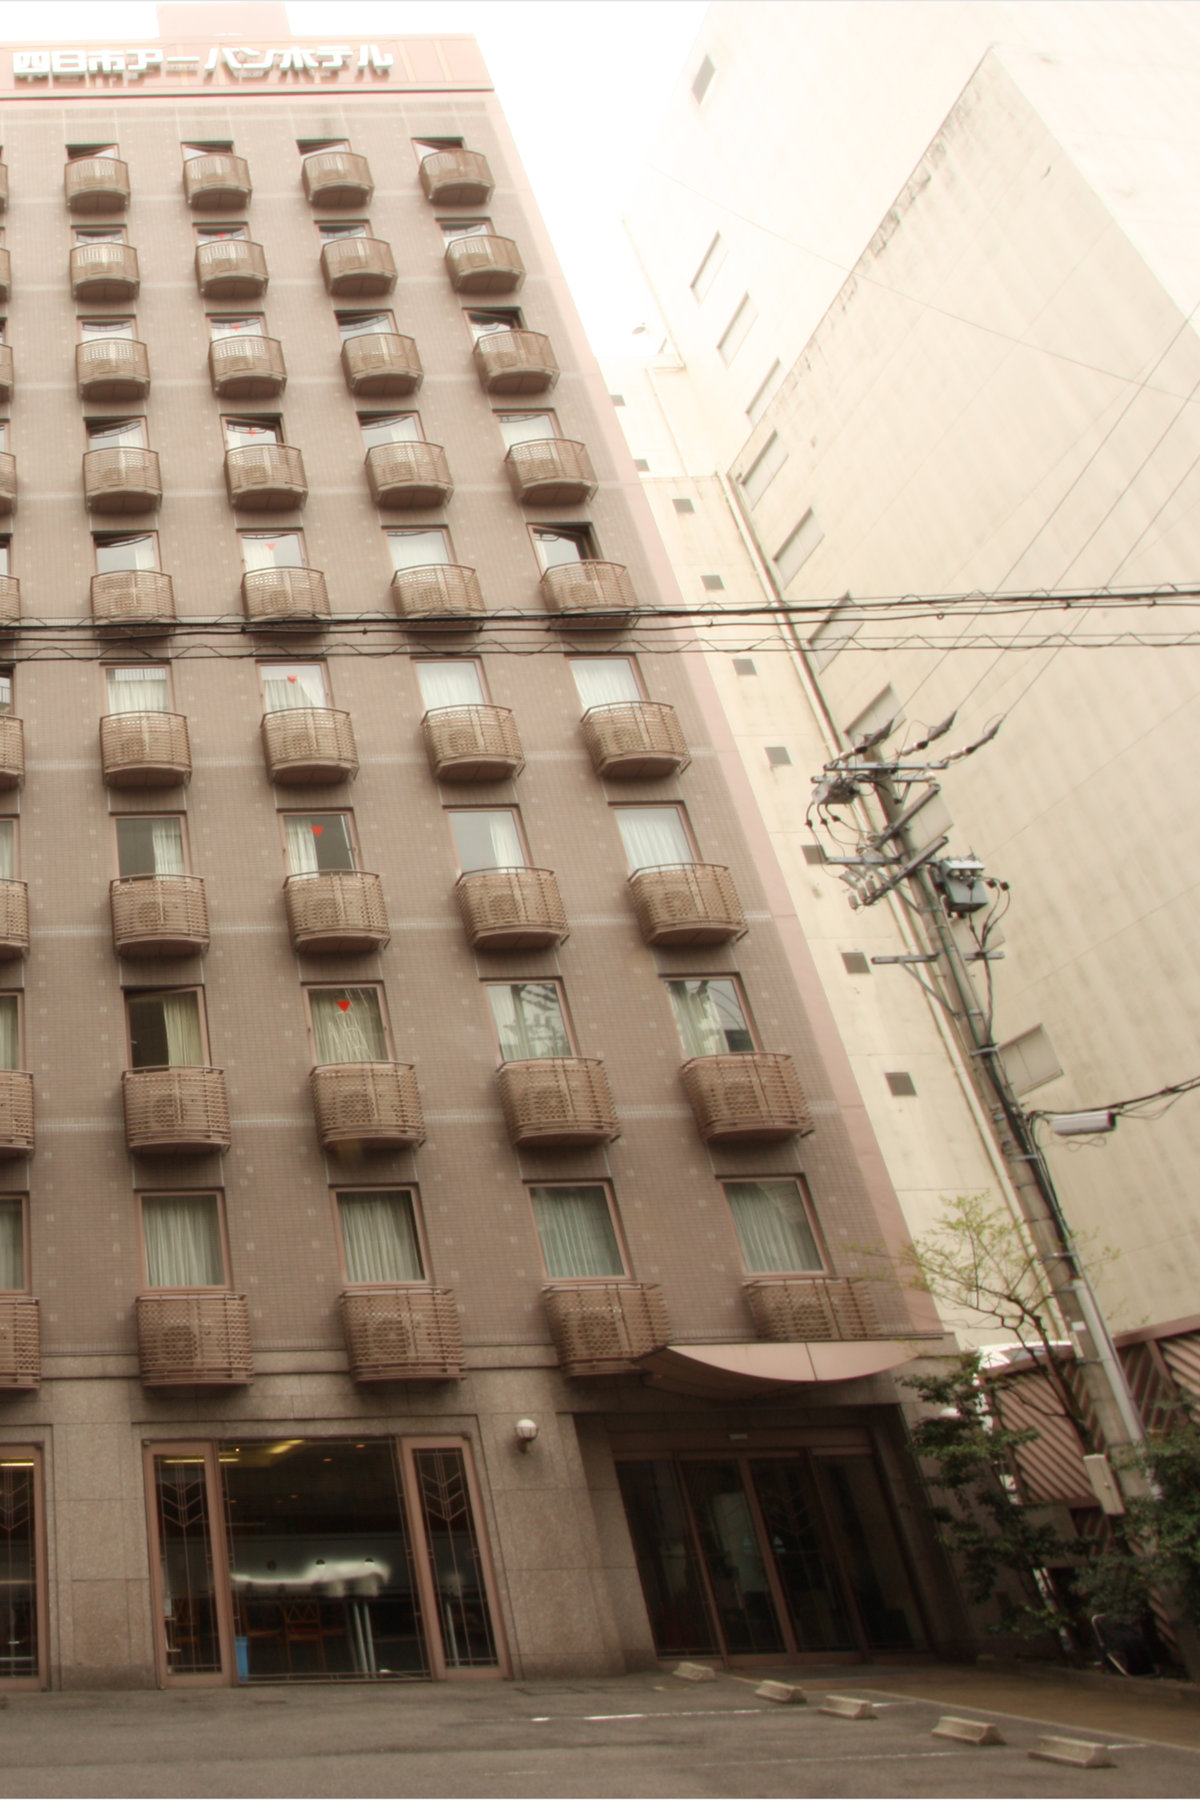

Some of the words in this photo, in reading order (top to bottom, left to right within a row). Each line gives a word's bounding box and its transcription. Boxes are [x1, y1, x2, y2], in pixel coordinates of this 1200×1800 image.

[12, 44, 394, 77] 四日市アーバンホテル
